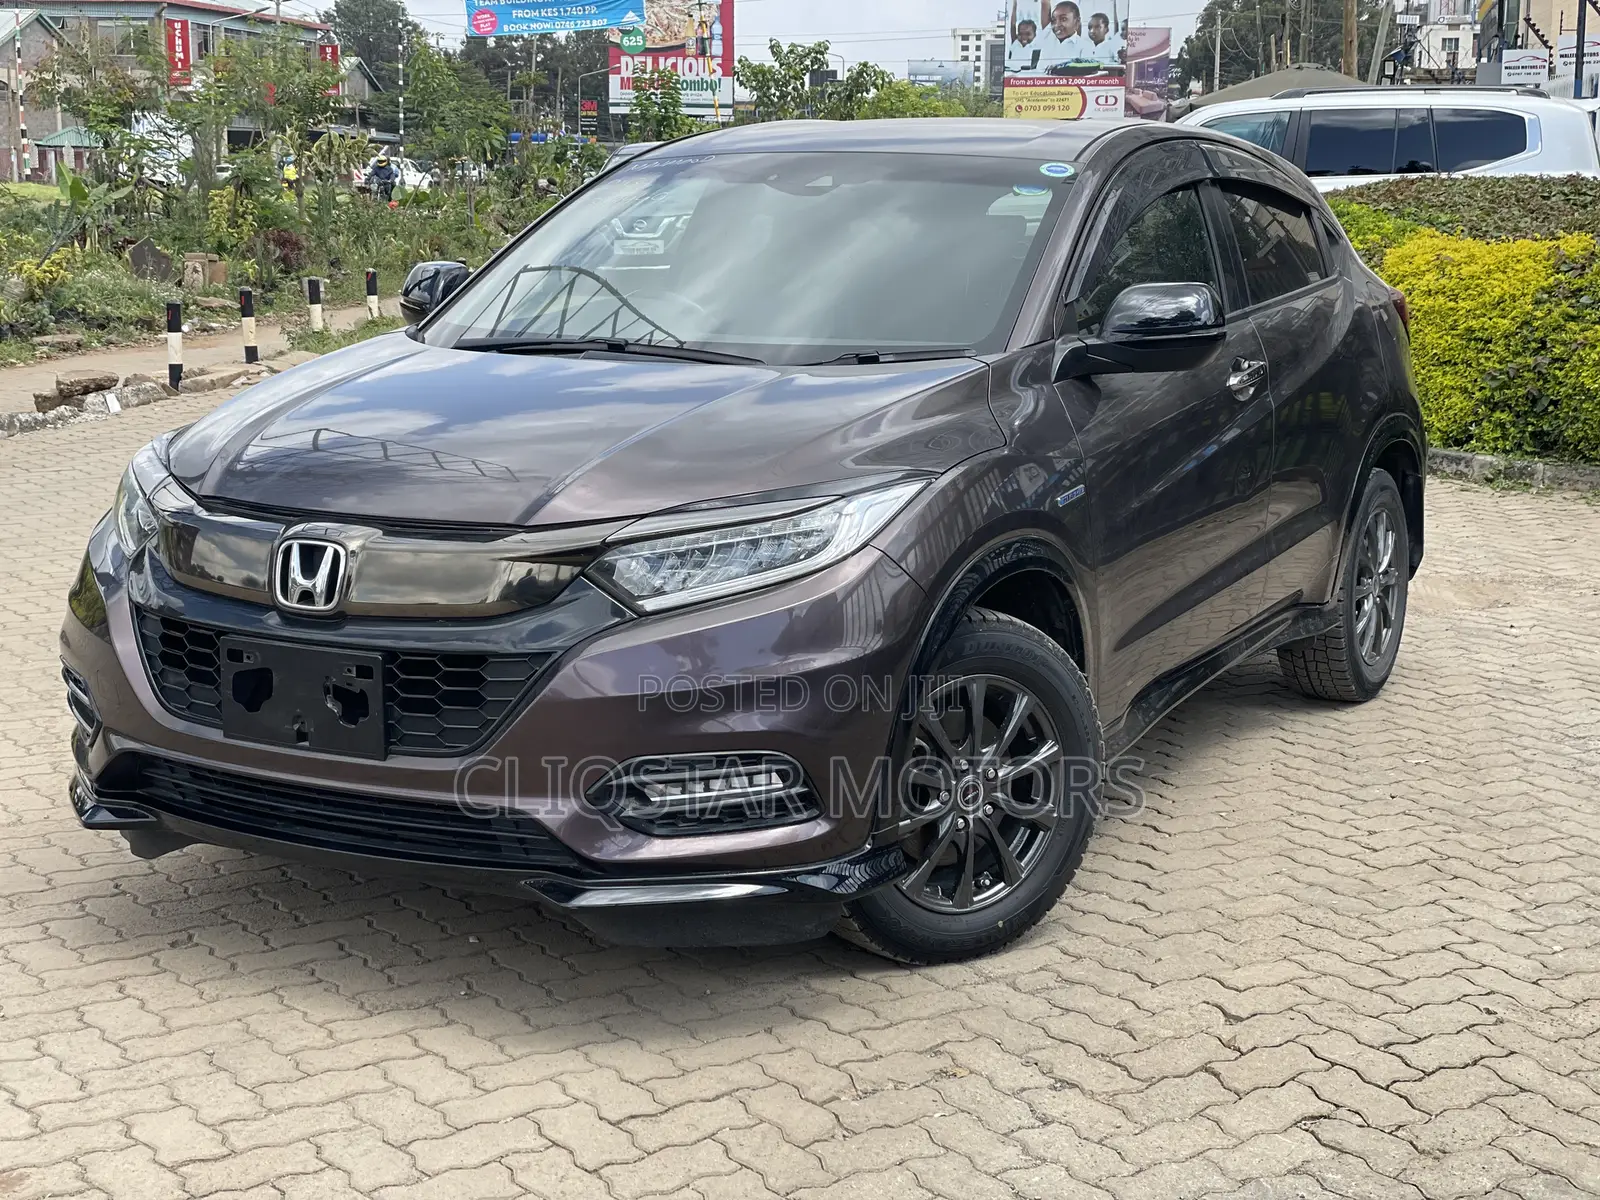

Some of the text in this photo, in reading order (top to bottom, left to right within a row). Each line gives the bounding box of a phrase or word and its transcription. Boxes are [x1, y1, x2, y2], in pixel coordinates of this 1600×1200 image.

[511, 9, 539, 18] FROM
[540, 7, 558, 17] KES
[503, 23, 528, 32] BOOK
[174, 21, 184, 68] UCHUMI
[622, 36, 643, 47] 625
[620, 55, 722, 77] DELICIOUS
[680, 77, 722, 93] ombo!
[1068, 78, 1086, 86] 2,000
[1098, 77, 1120, 85] month
[581, 101, 597, 110] 3M
